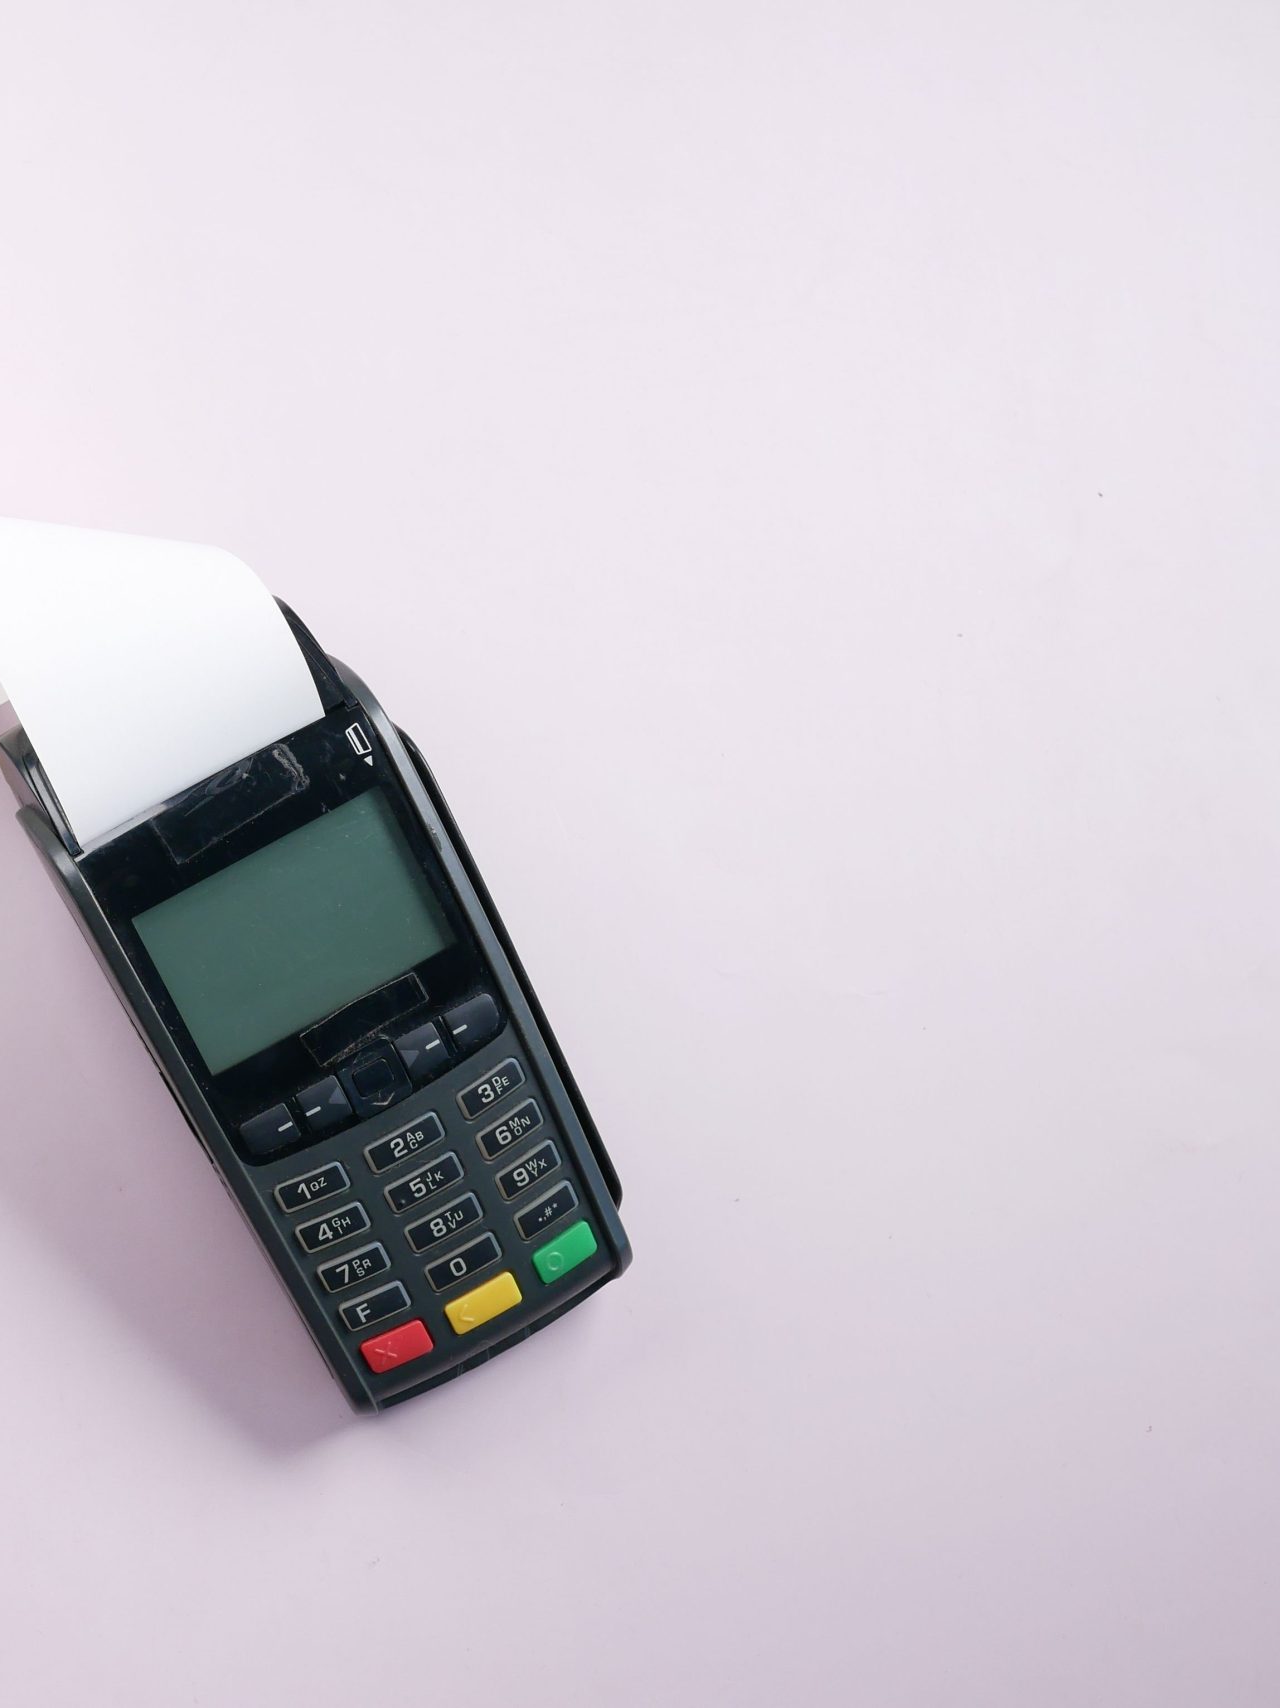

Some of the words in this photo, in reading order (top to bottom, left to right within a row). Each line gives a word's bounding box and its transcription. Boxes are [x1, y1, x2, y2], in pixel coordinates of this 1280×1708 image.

[477, 1083, 495, 1103] 3
[495, 1125, 512, 1145] 6
[390, 1138, 408, 1158] 2
[513, 1167, 530, 1187] 9
[297, 1182, 312, 1200] 1
[409, 1178, 427, 1198] 5
[318, 1223, 334, 1241] 4
[429, 1218, 447, 1238] 8
[335, 1264, 350, 1284] 7
[449, 1257, 467, 1277] 0
[355, 1303, 371, 1324] F
